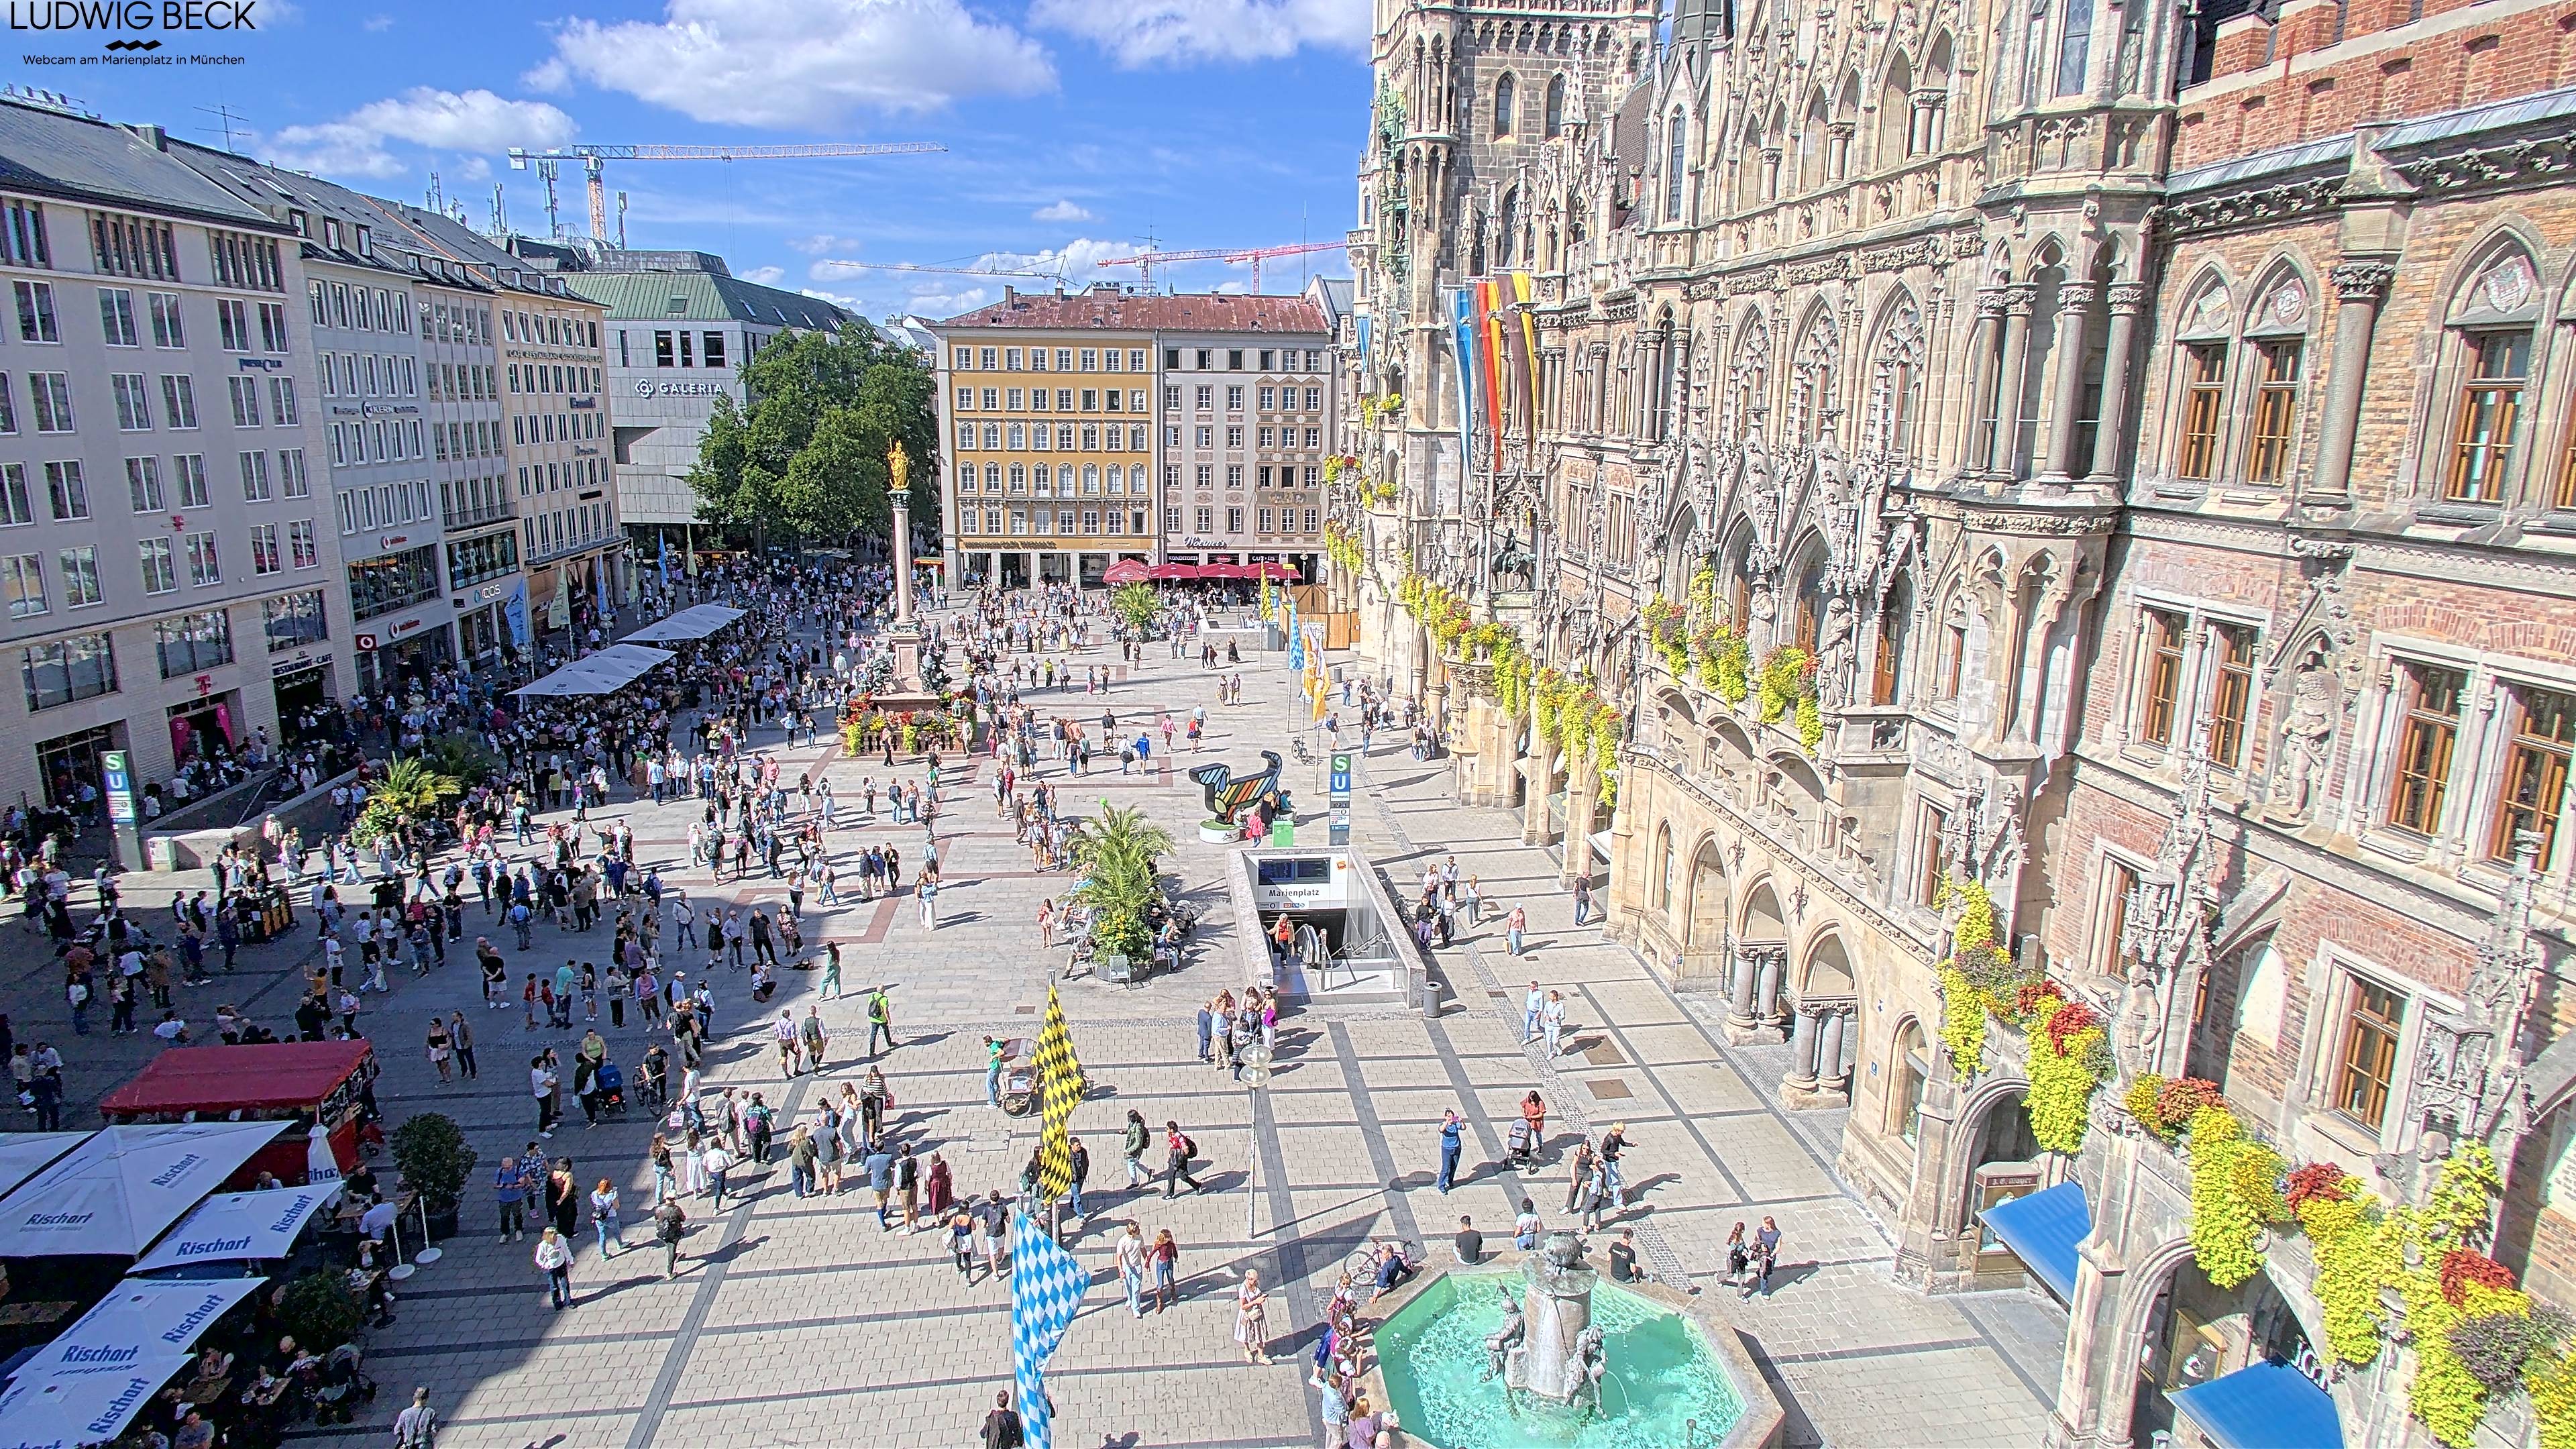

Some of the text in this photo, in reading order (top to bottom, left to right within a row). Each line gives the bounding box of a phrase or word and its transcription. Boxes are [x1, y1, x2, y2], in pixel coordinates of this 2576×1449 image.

[659, 383, 722, 392] GALERIA
[373, 405, 394, 413] KERN
[481, 584, 500, 598] IQOS
[1270, 588, 1277, 597] S
[1271, 598, 1277, 606] U
[105, 755, 121, 770] S
[1334, 756, 1347, 771] S
[109, 774, 123, 789] U
[1334, 775, 1346, 790] U
[1269, 889, 1319, 898] Marienplatz
[150, 1154, 200, 1186] Rischart
[25, 1212, 94, 1226] Rischart
[270, 1194, 313, 1233] Rischart
[176, 1236, 252, 1256] Rischart
[161, 1293, 225, 1343] Rischart
[60, 1345, 140, 1362] Rischart
[86, 1377, 150, 1434] Rischart
